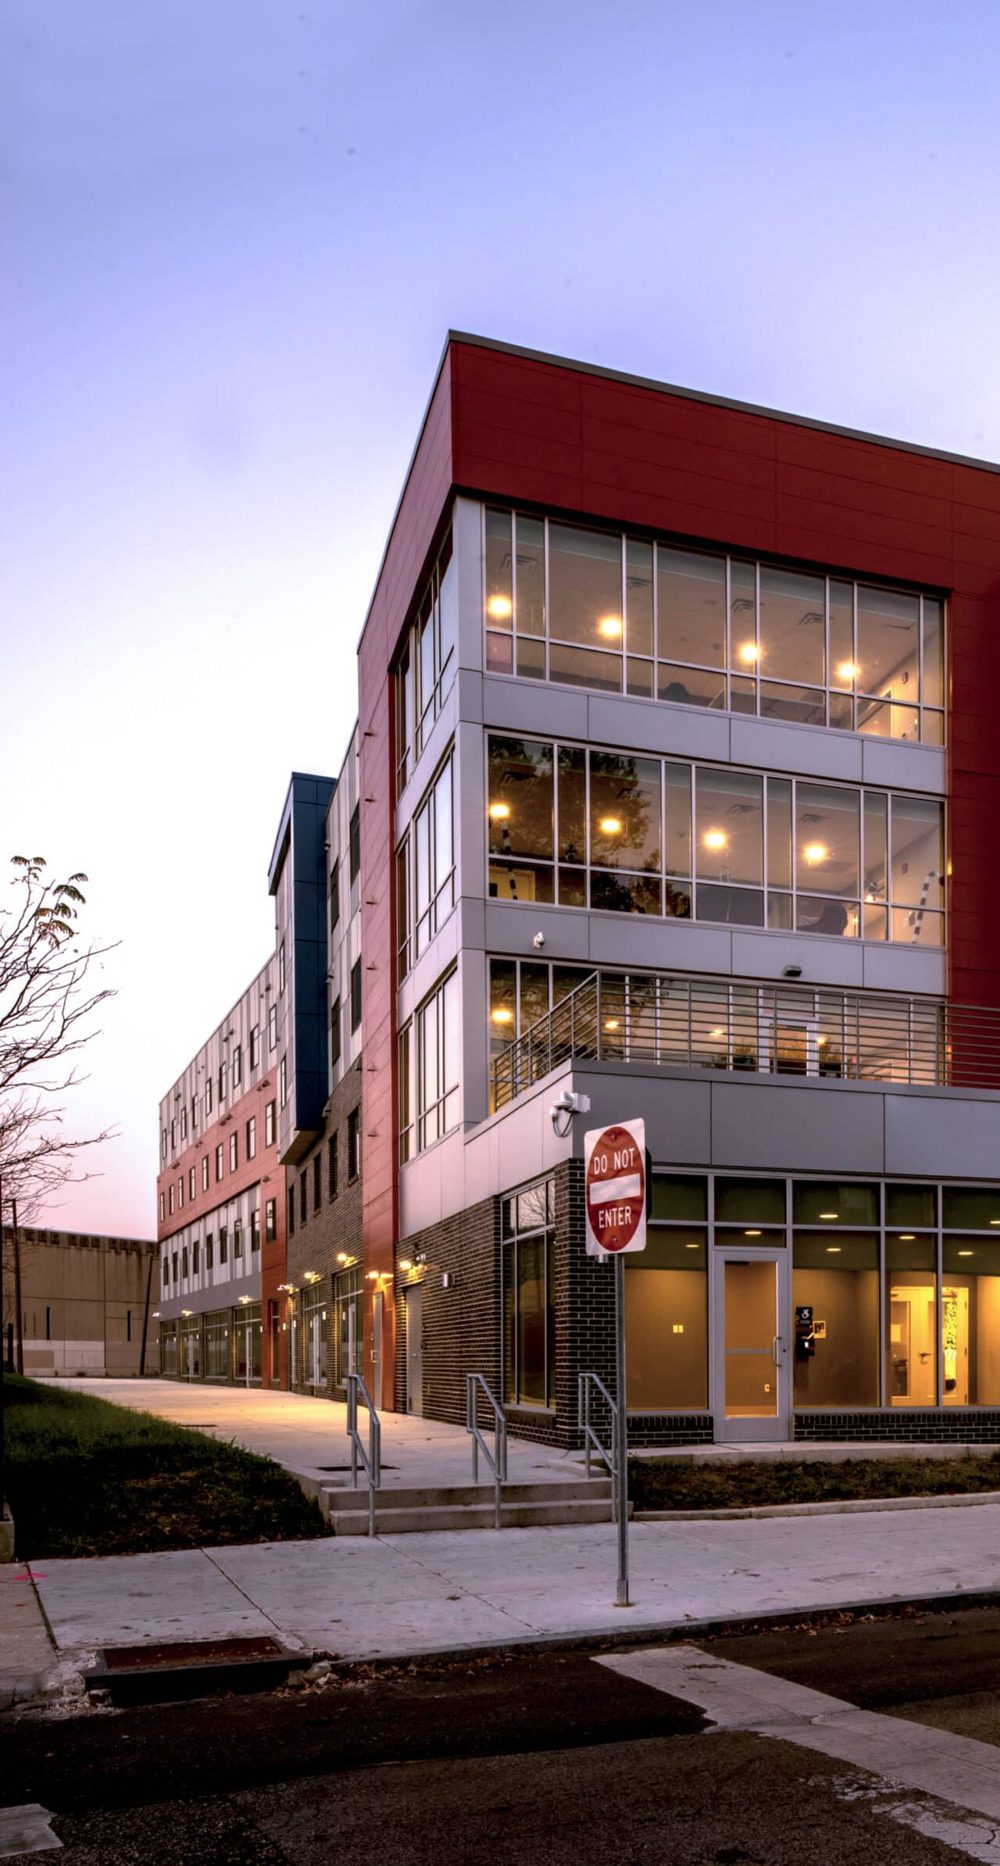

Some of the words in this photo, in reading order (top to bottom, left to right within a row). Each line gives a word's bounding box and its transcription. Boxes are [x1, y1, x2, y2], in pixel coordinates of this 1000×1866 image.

[594, 1155, 608, 1174] DO
[614, 1148, 635, 1170] NOT
[599, 1206, 632, 1228] ENTER
